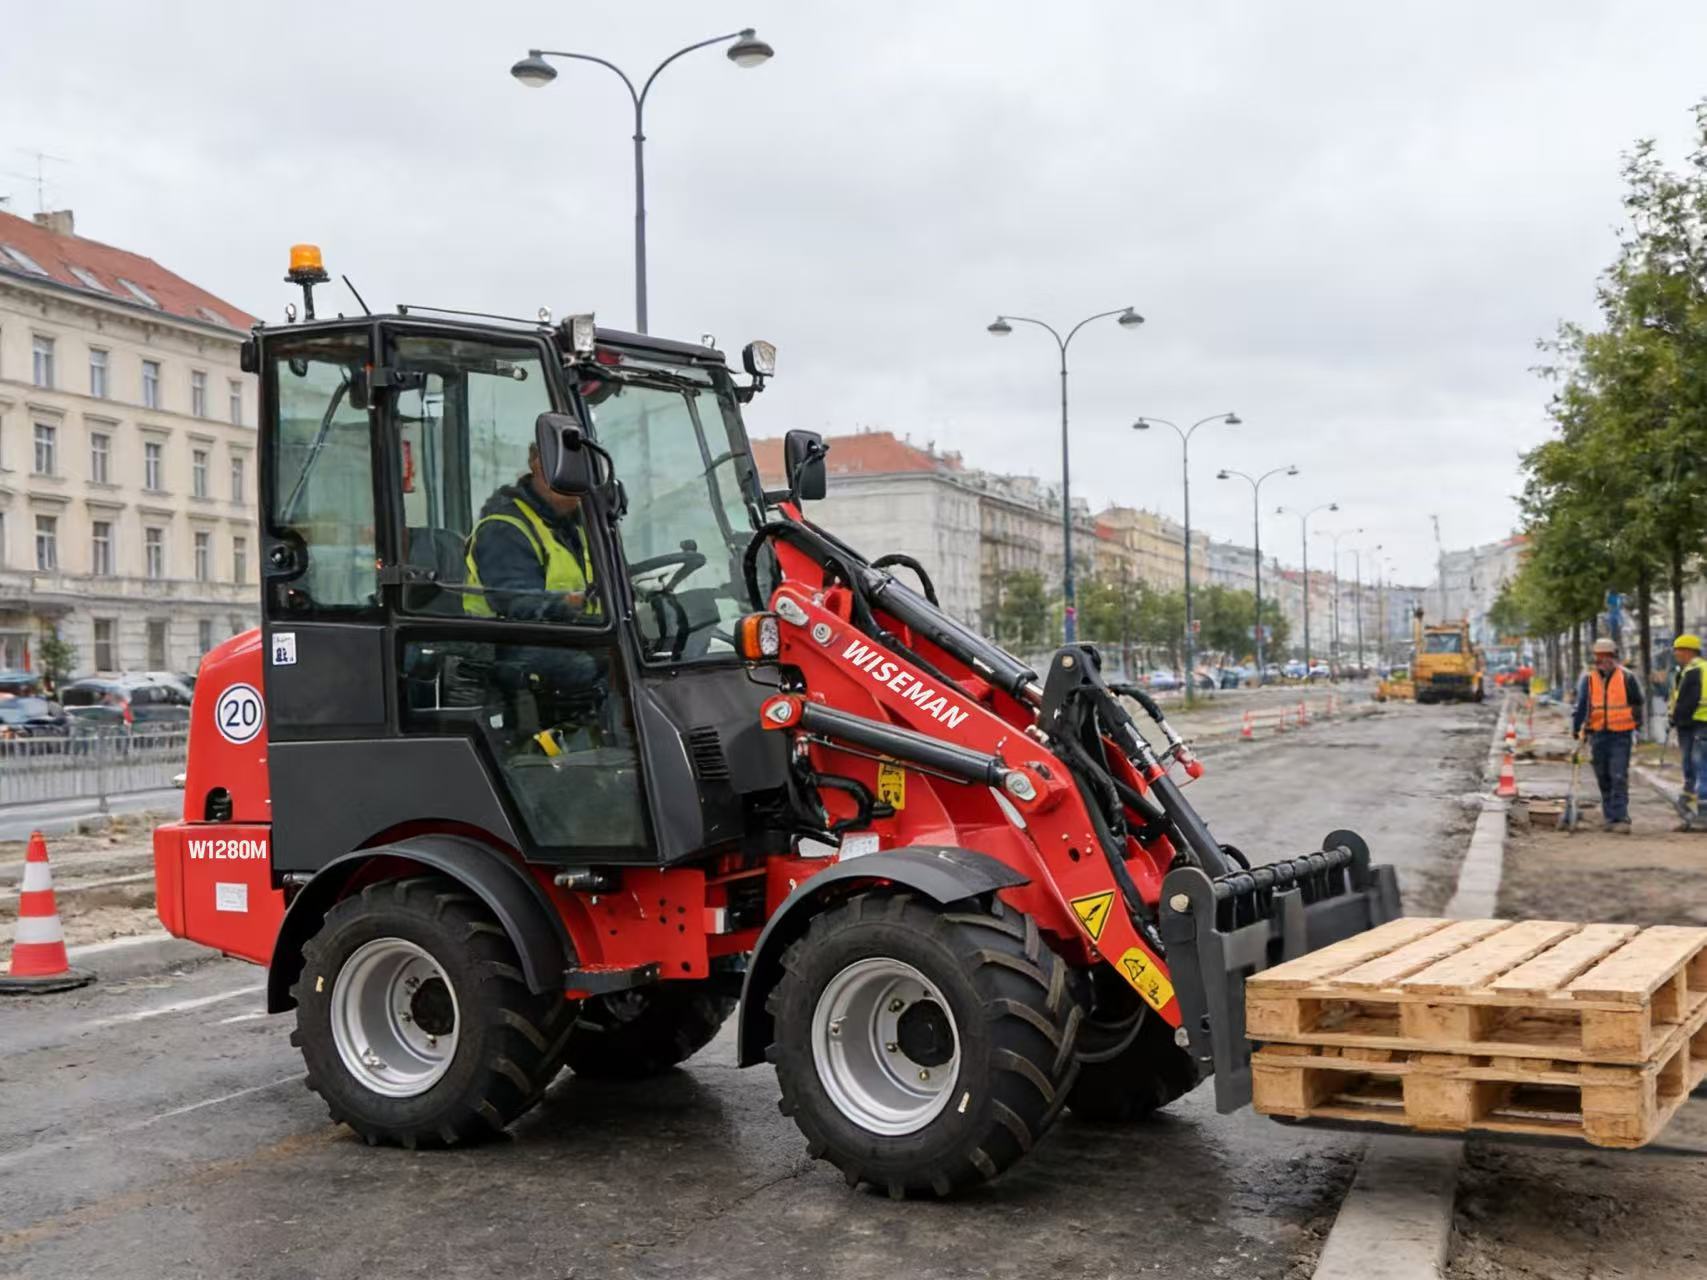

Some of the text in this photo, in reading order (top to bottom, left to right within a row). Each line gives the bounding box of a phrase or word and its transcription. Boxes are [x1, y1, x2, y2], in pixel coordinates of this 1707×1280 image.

[842, 639, 969, 729] WISEMAN
[224, 699, 257, 727] 20
[188, 840, 267, 859] W1280M
